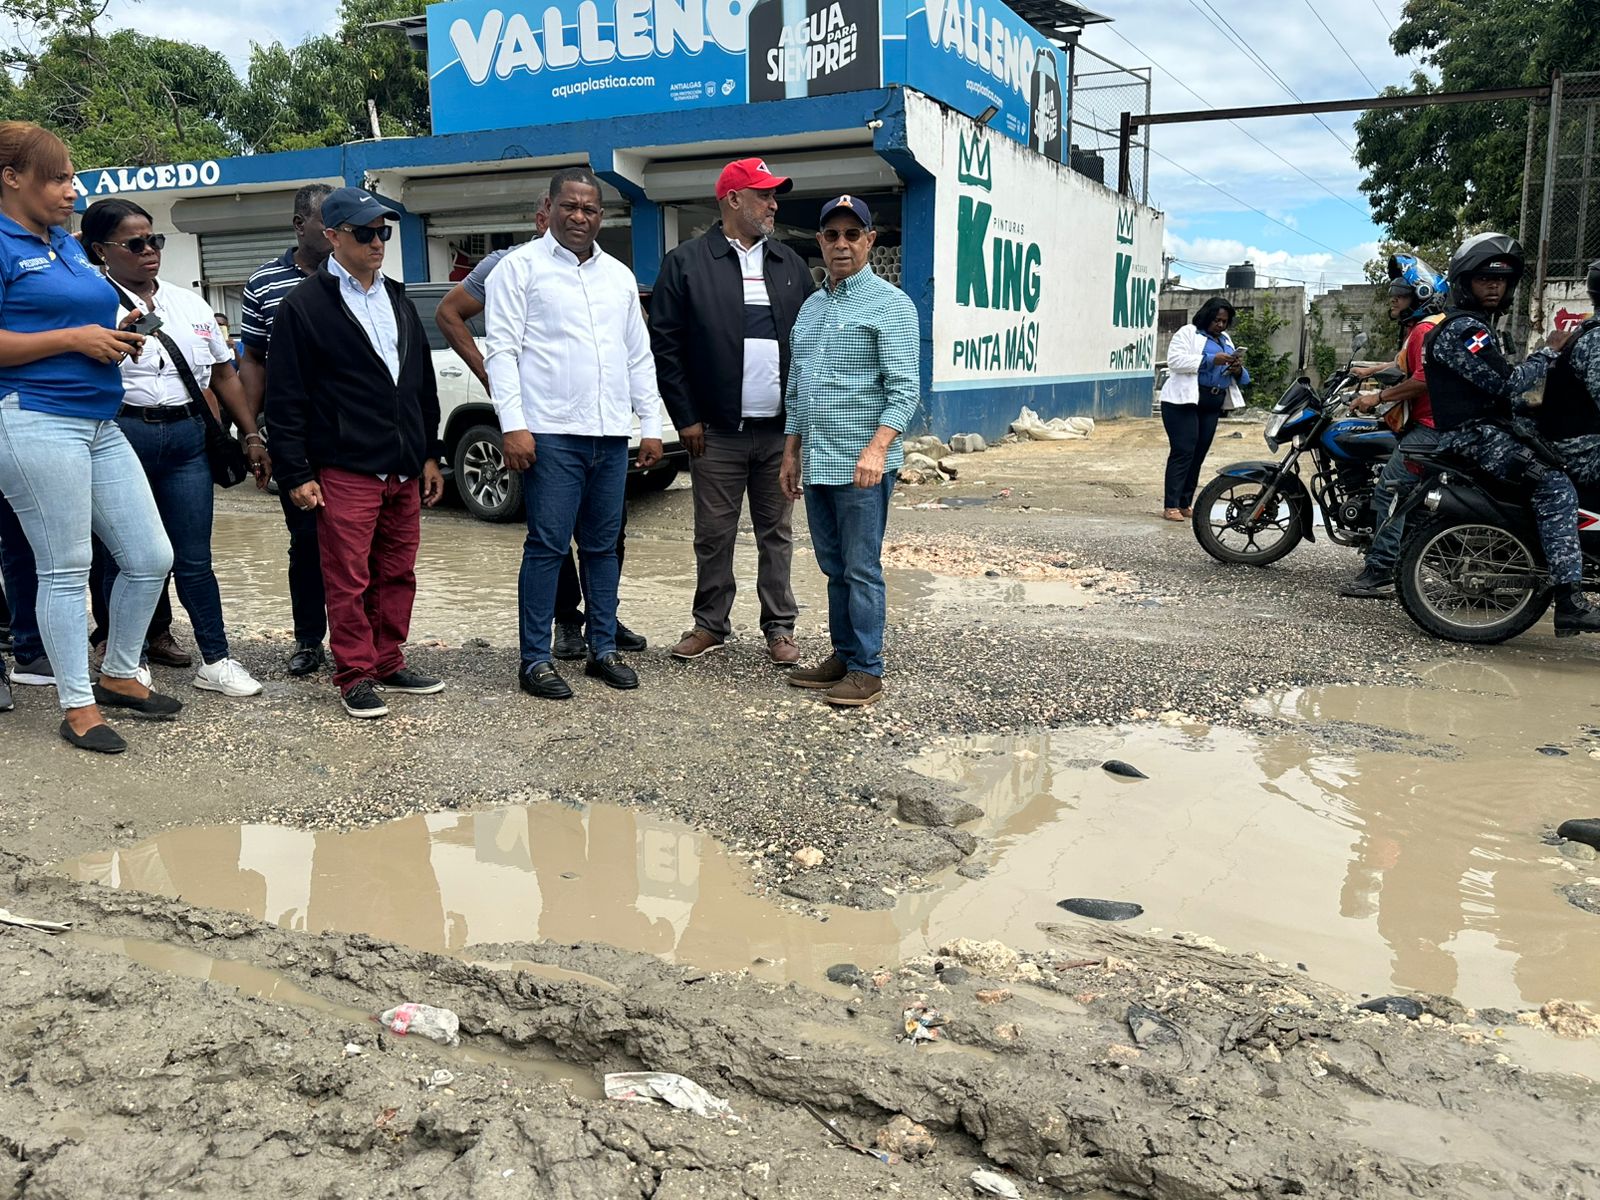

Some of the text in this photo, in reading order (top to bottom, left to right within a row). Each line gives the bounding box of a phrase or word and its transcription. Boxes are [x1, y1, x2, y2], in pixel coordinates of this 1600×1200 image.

[778, 2, 845, 47] AGUA
[827, 23, 858, 43] PARA
[767, 32, 858, 82] SIEMPRE!
[551, 75, 655, 98] aquaplastica.com
[95, 160, 220, 194] ALCEDO
[993, 217, 1025, 235] PINTURAS
[956, 195, 1041, 313] KING
[1113, 252, 1156, 328] KING
[953, 316, 1040, 373] PINTA MÁS!
[1109, 345, 1134, 370] PINTA
